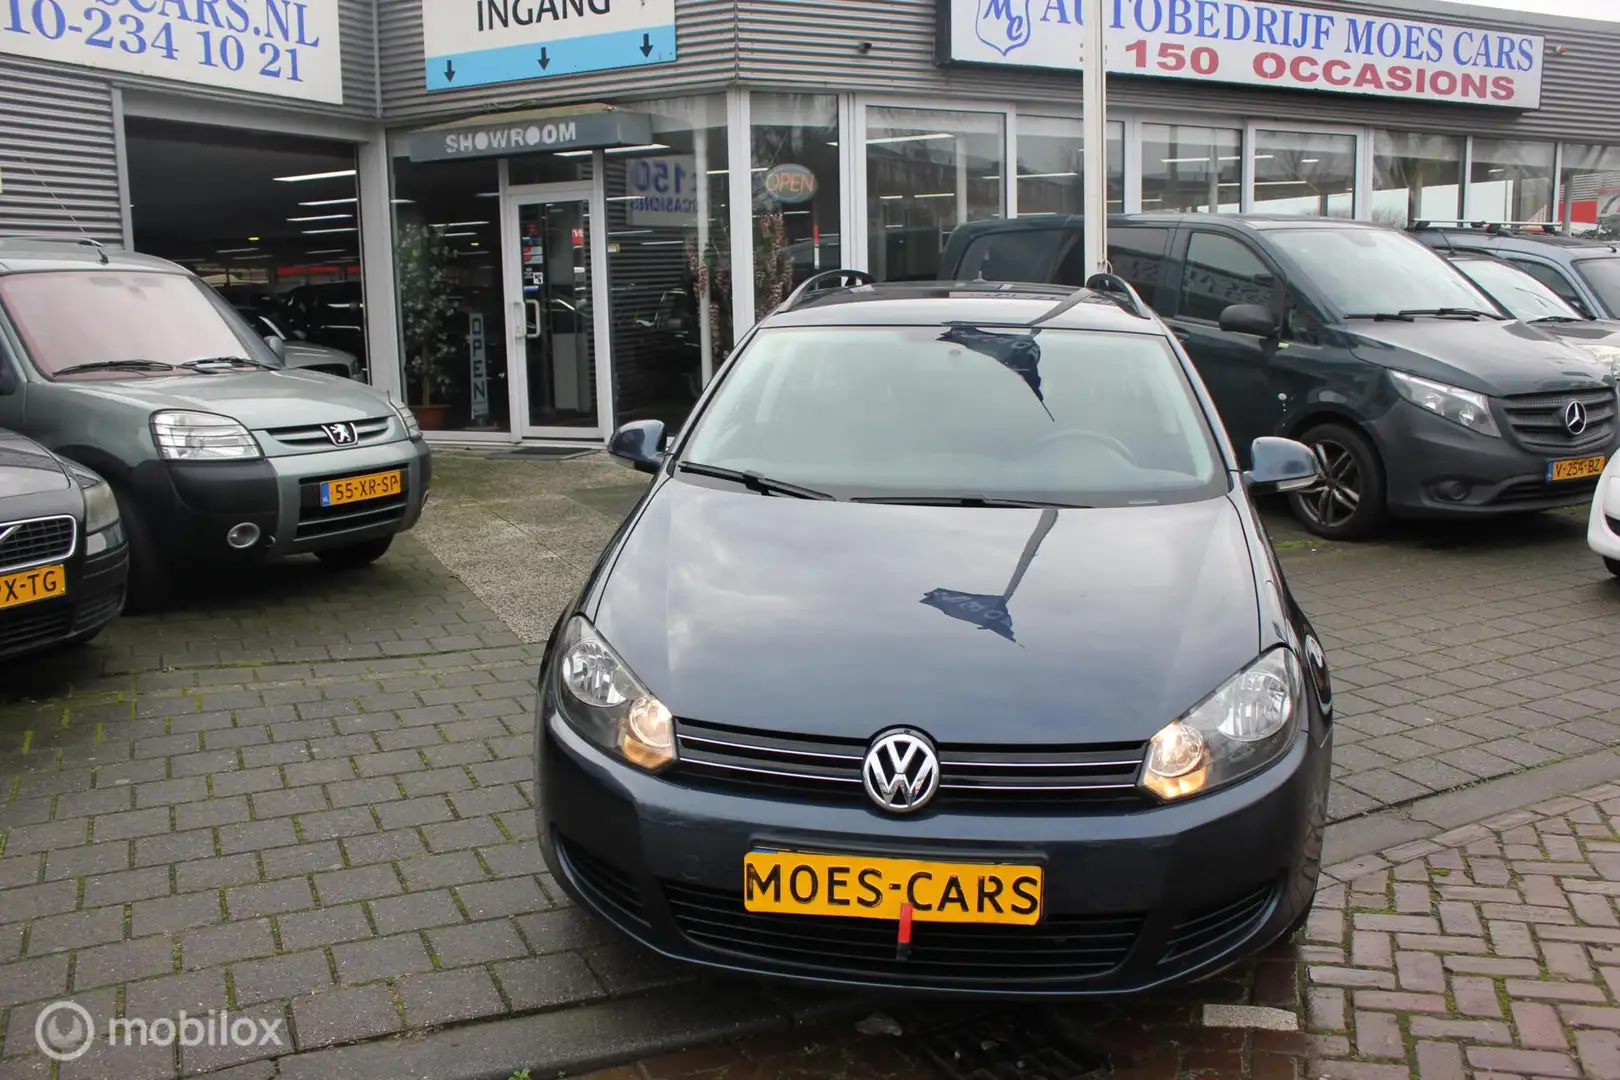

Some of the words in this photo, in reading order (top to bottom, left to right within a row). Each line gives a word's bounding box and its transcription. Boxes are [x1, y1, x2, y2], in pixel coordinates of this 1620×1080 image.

[196, 30, 244, 72] 10
[259, 42, 303, 82] 21
[1040, 0, 1335, 51] ATOBEDRIJF
[1344, 18, 1443, 63] MOES
[1453, 31, 1533, 72] CARS
[1125, 39, 1219, 75] 150
[1252, 51, 1514, 101] OCCASIONS
[445, 121, 577, 153] SHOWROOM
[766, 174, 815, 193] OPEN
[472, 318, 486, 400] OPEN
[335, 475, 398, 501] 55-XR-SP
[0, 570, 57, 603] X-TG
[746, 862, 1038, 915] MOES-CARS
